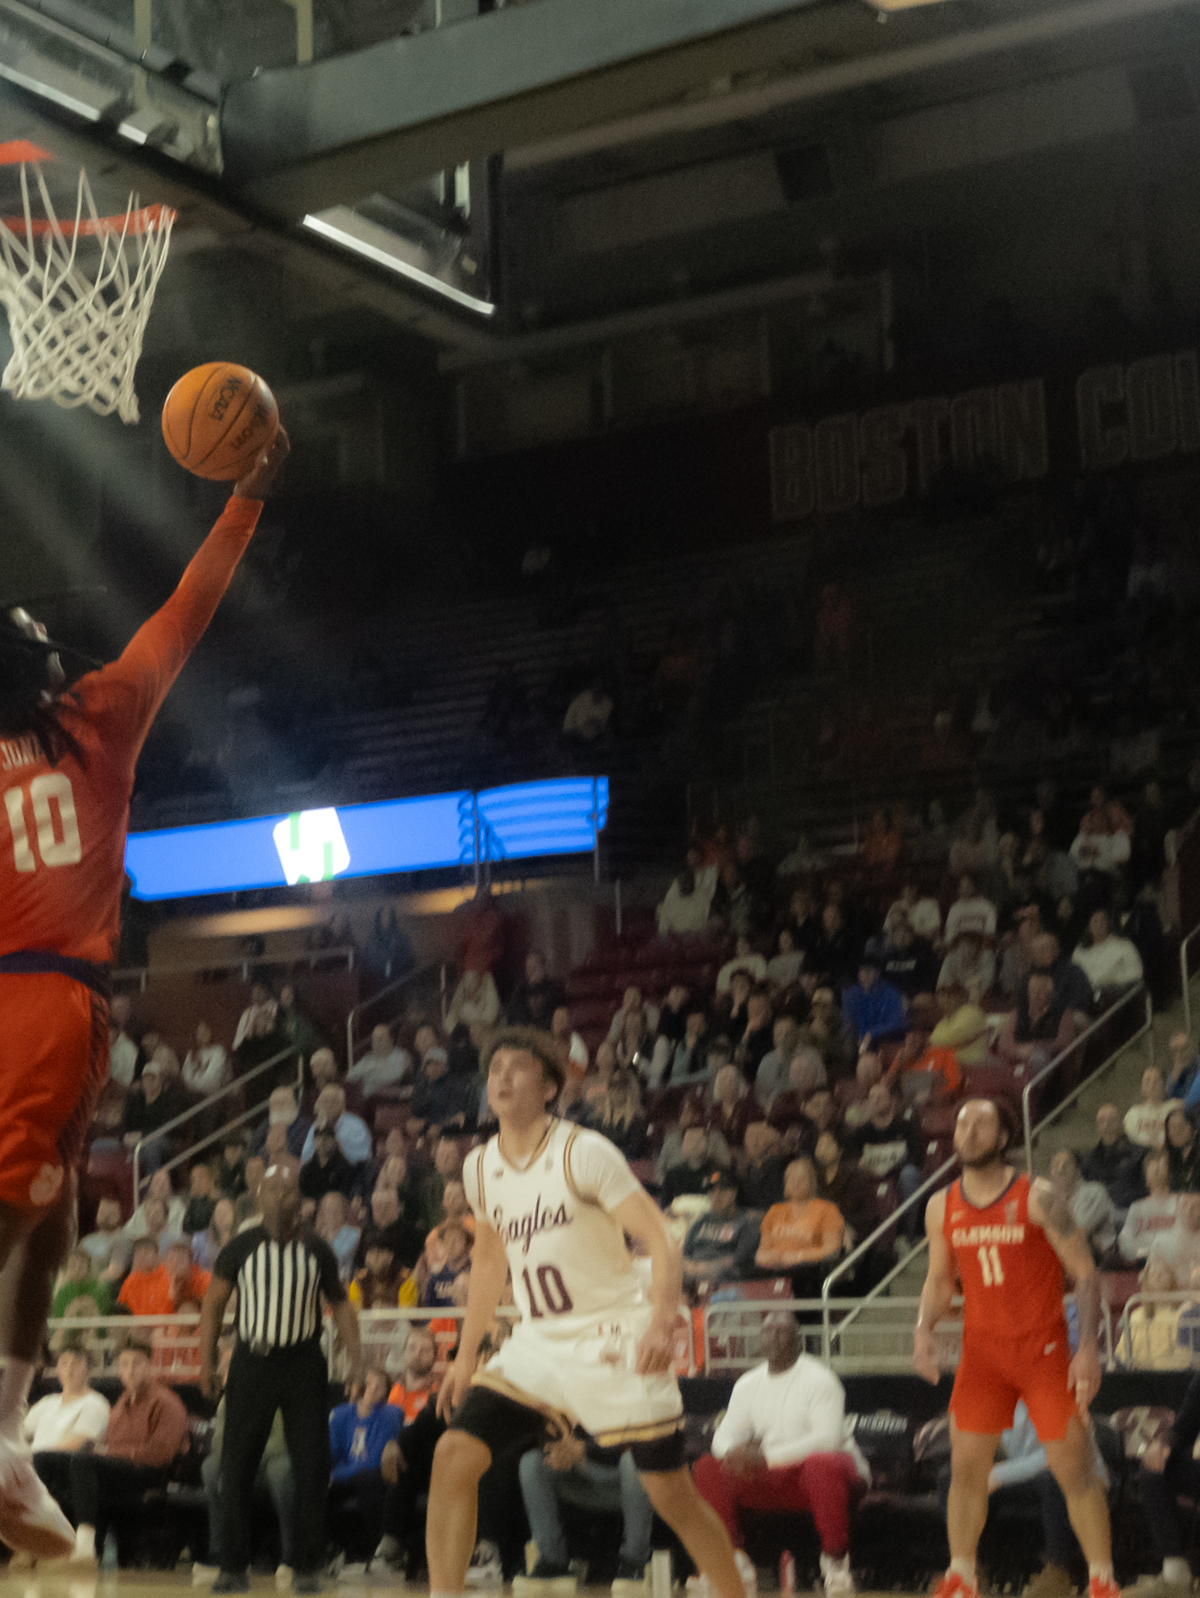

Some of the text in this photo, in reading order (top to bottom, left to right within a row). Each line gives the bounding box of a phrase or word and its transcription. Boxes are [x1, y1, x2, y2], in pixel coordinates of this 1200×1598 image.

[767, 376, 1048, 522] BOSTON
[4, 772, 82, 873] 10
[522, 1263, 575, 1320] 10
[977, 1244, 1005, 1287] 11
